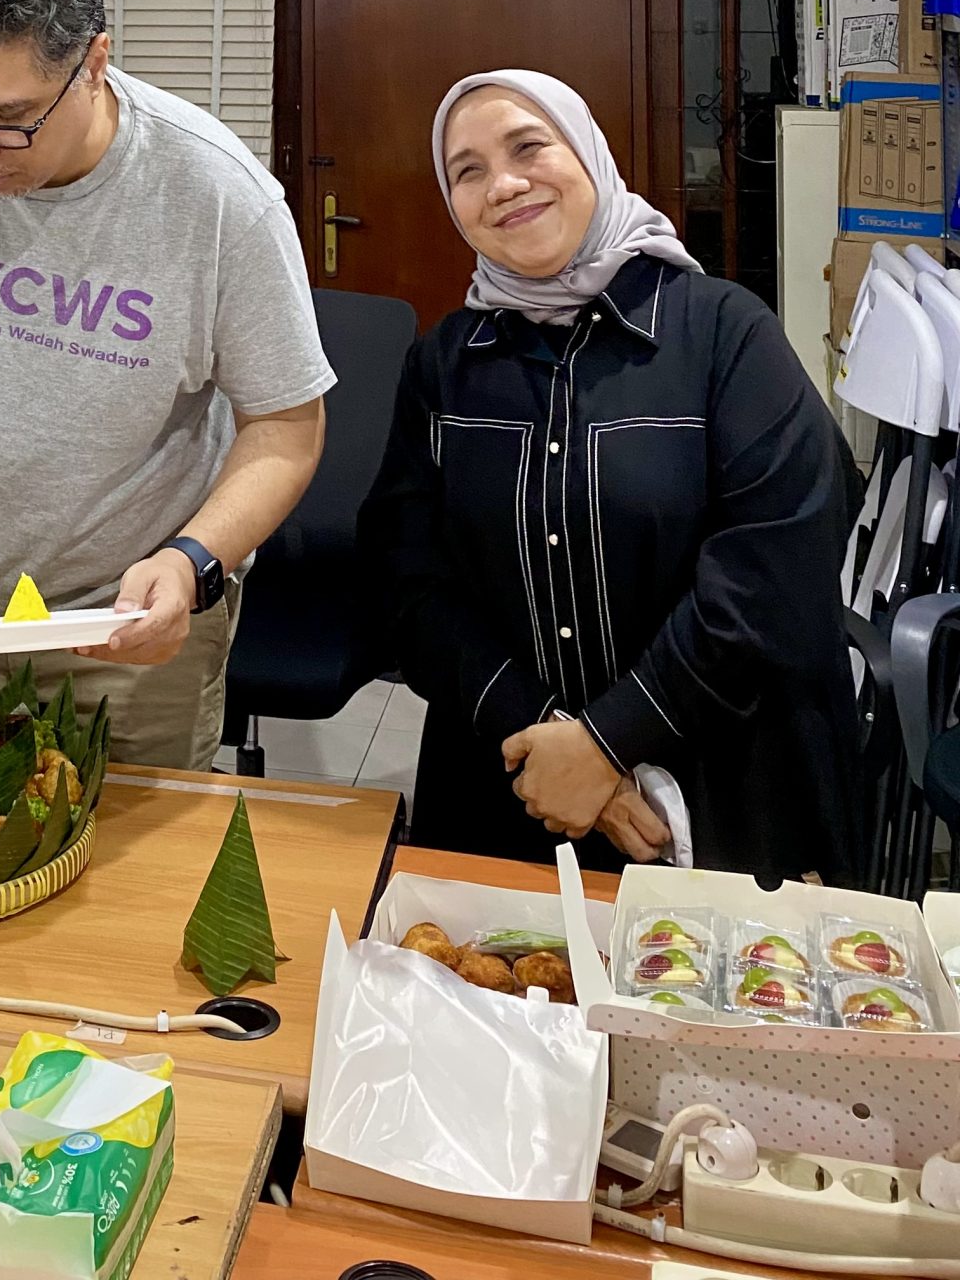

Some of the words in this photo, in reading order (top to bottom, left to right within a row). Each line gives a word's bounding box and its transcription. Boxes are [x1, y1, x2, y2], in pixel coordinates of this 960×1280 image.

[9, 324, 64, 352] Wadah
[68, 341, 150, 370] Swadaya
[62, 1163, 78, 1185] 30%
